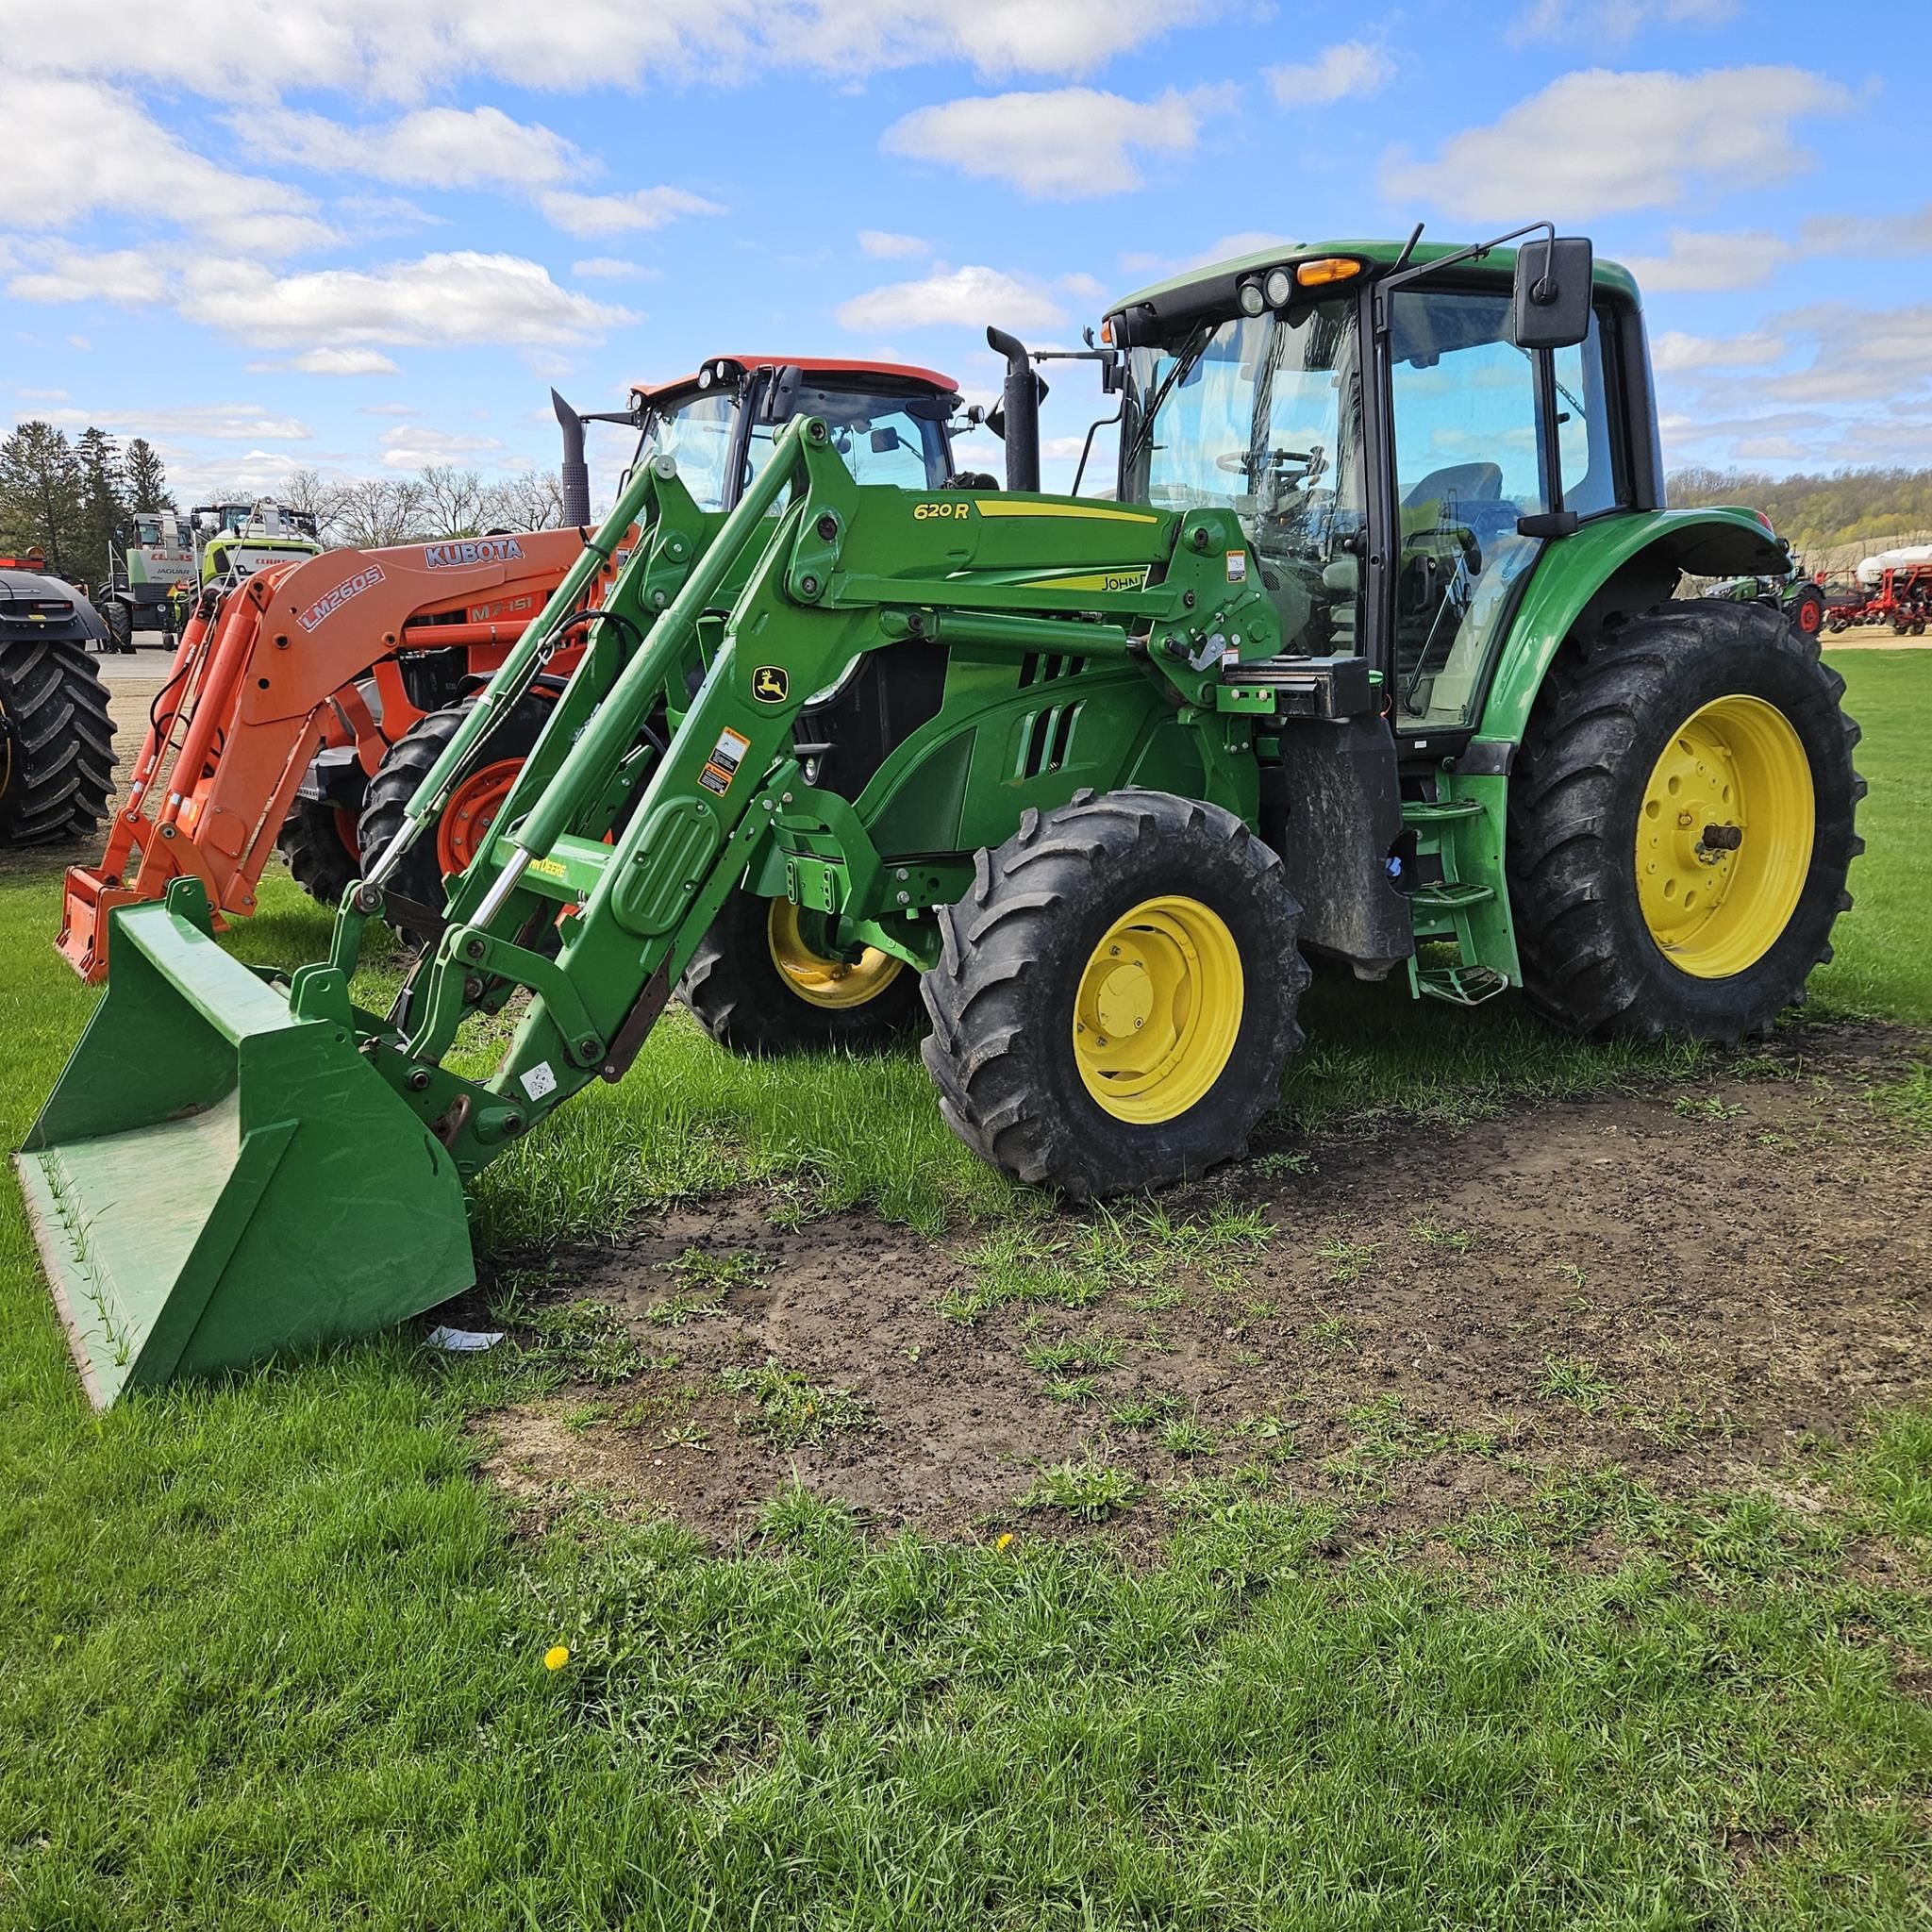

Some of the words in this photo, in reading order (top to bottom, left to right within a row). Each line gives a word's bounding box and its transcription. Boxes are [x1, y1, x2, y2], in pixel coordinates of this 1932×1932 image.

[151, 554, 192, 562] CLS
[425, 539, 525, 568] KUBOTA
[1102, 576, 1138, 591] JOHN
[302, 568, 380, 628] LM2605
